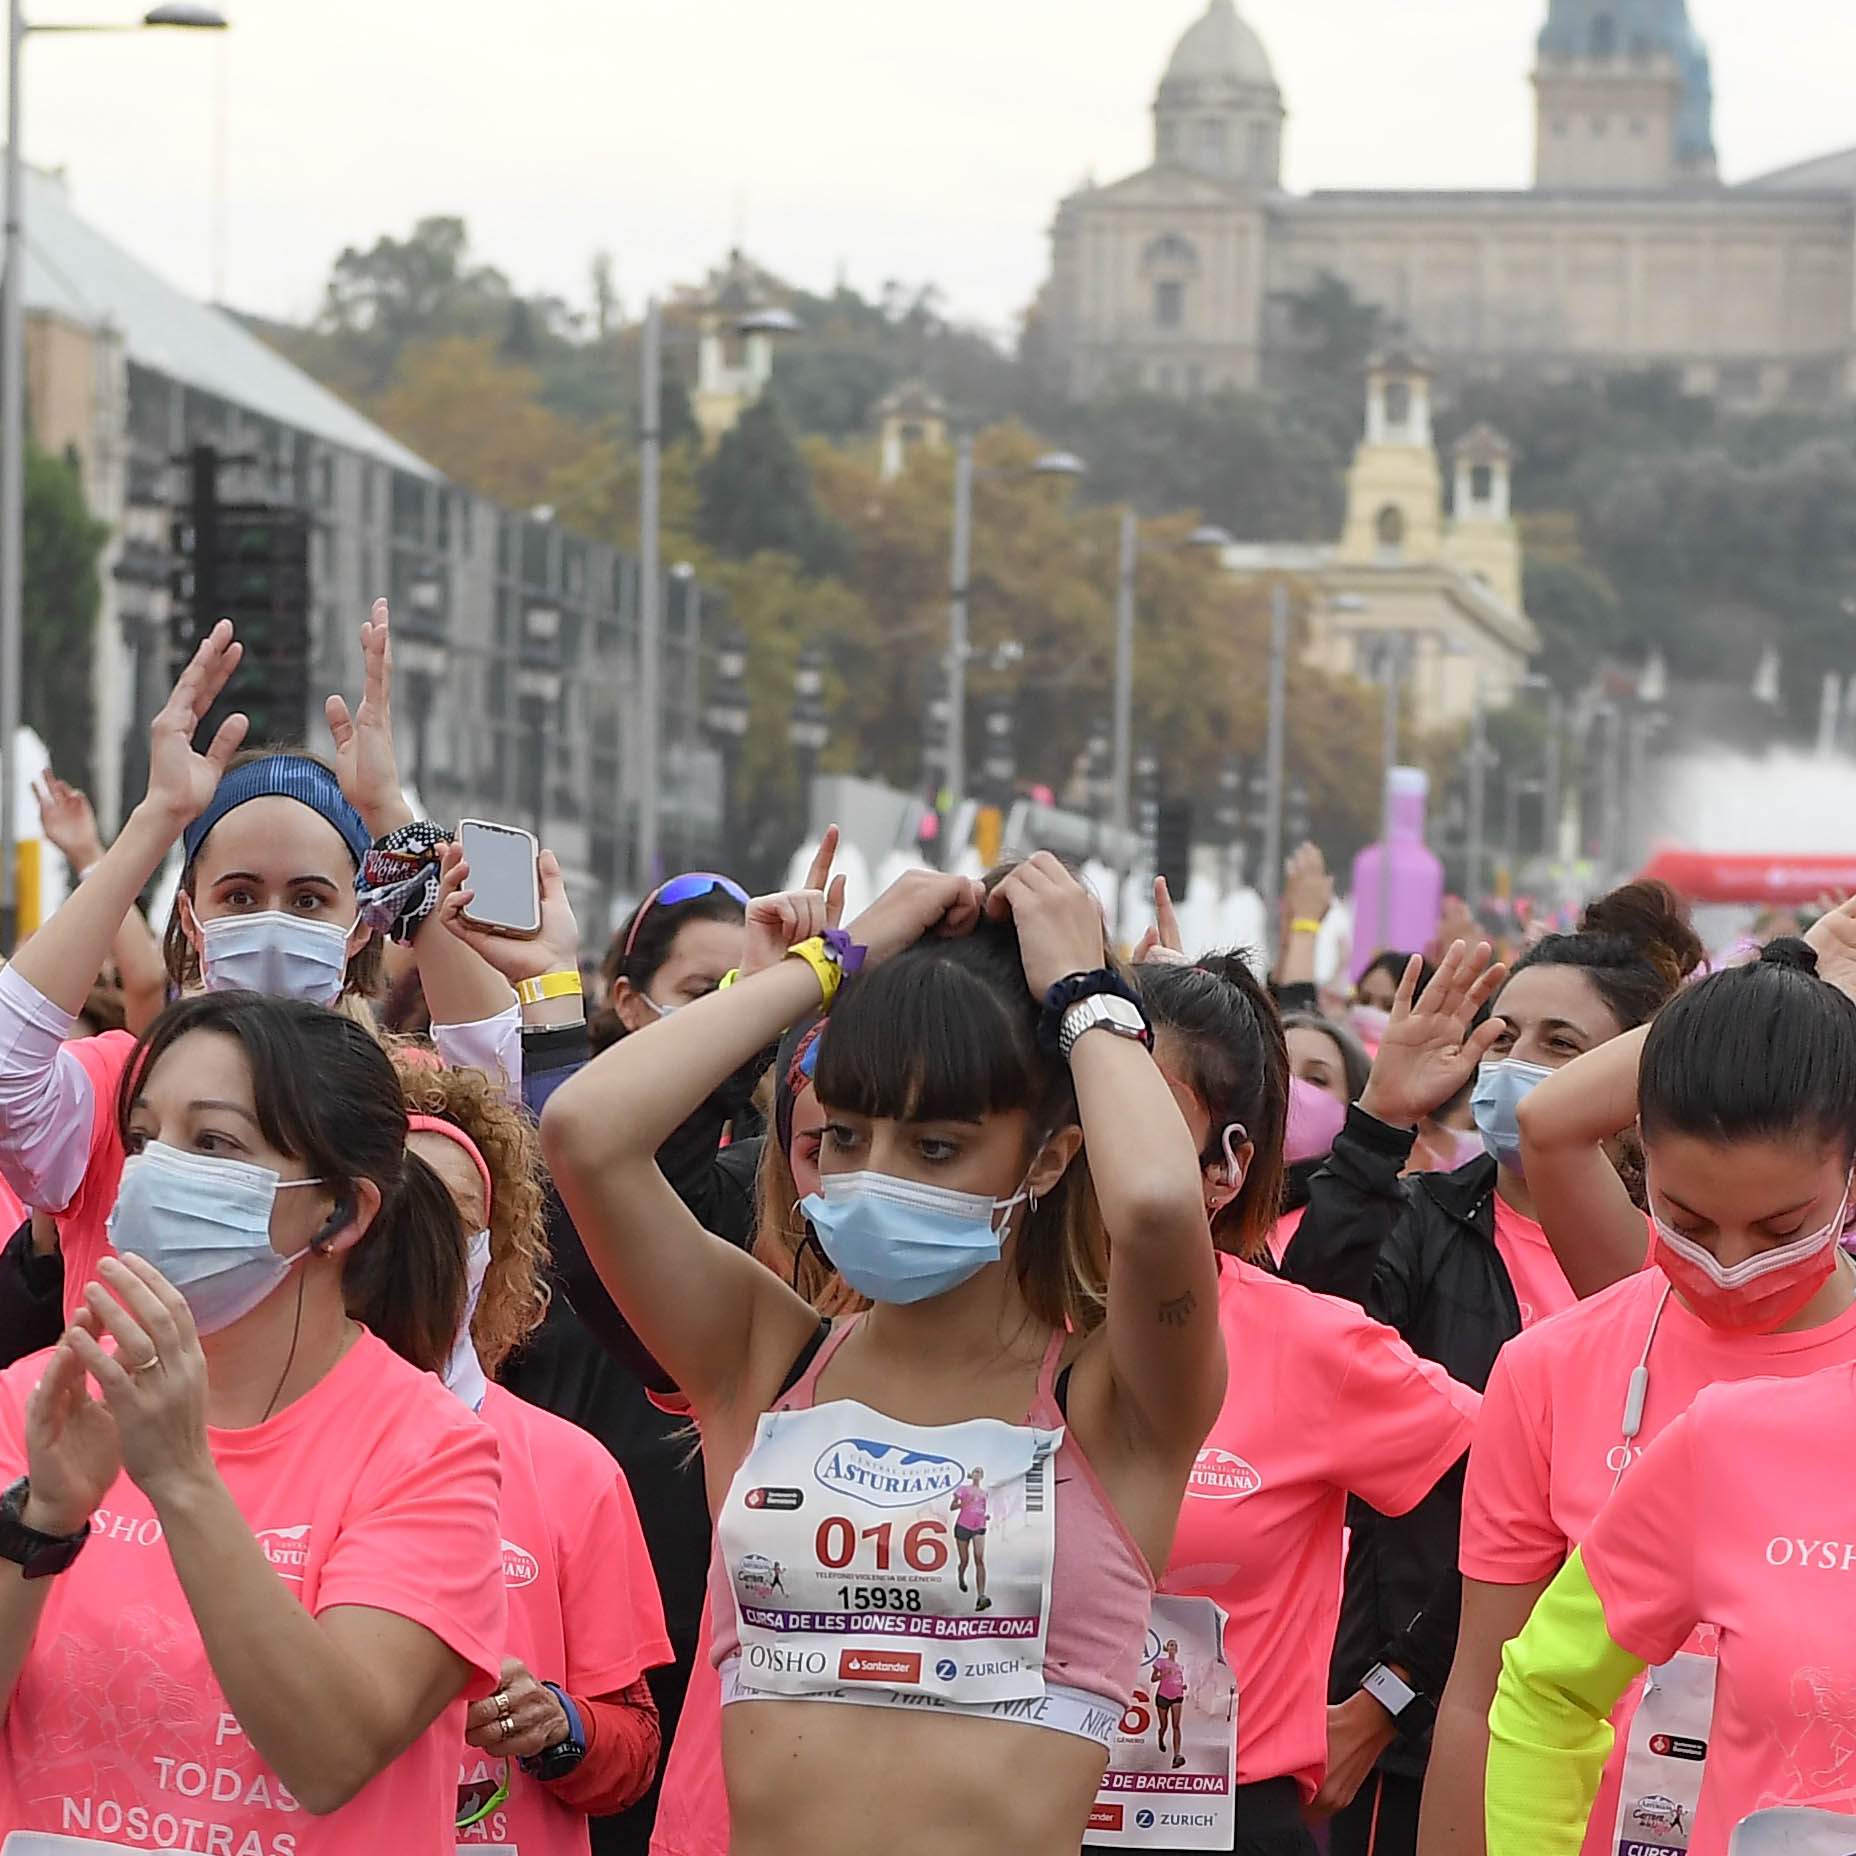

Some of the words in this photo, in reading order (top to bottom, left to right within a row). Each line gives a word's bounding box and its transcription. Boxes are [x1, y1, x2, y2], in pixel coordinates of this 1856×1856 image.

[822, 1451, 953, 1494] ASTURIANA
[91, 1508, 162, 1546] SHO
[815, 1515, 948, 1572] 016
[838, 1586, 922, 1612] 15938
[746, 1611, 784, 1629] CURSA
[789, 1613, 811, 1629] DE
[815, 1614, 846, 1631] LES
[850, 1615, 905, 1633] DONES
[909, 1618, 932, 1634] DE
[935, 1618, 1035, 1637] BARCELONA
[750, 1646, 826, 1673] OYSHO
[861, 1659, 911, 1674] Santander
[964, 1660, 1019, 1677] ZURICH
[1080, 1708, 1117, 1742] NIKE
[153, 1756, 301, 1813] TODAS
[1112, 1774, 1134, 1790] DE
[1137, 1774, 1225, 1791] BARCELONA
[1161, 1812, 1215, 1828] ZURICH
